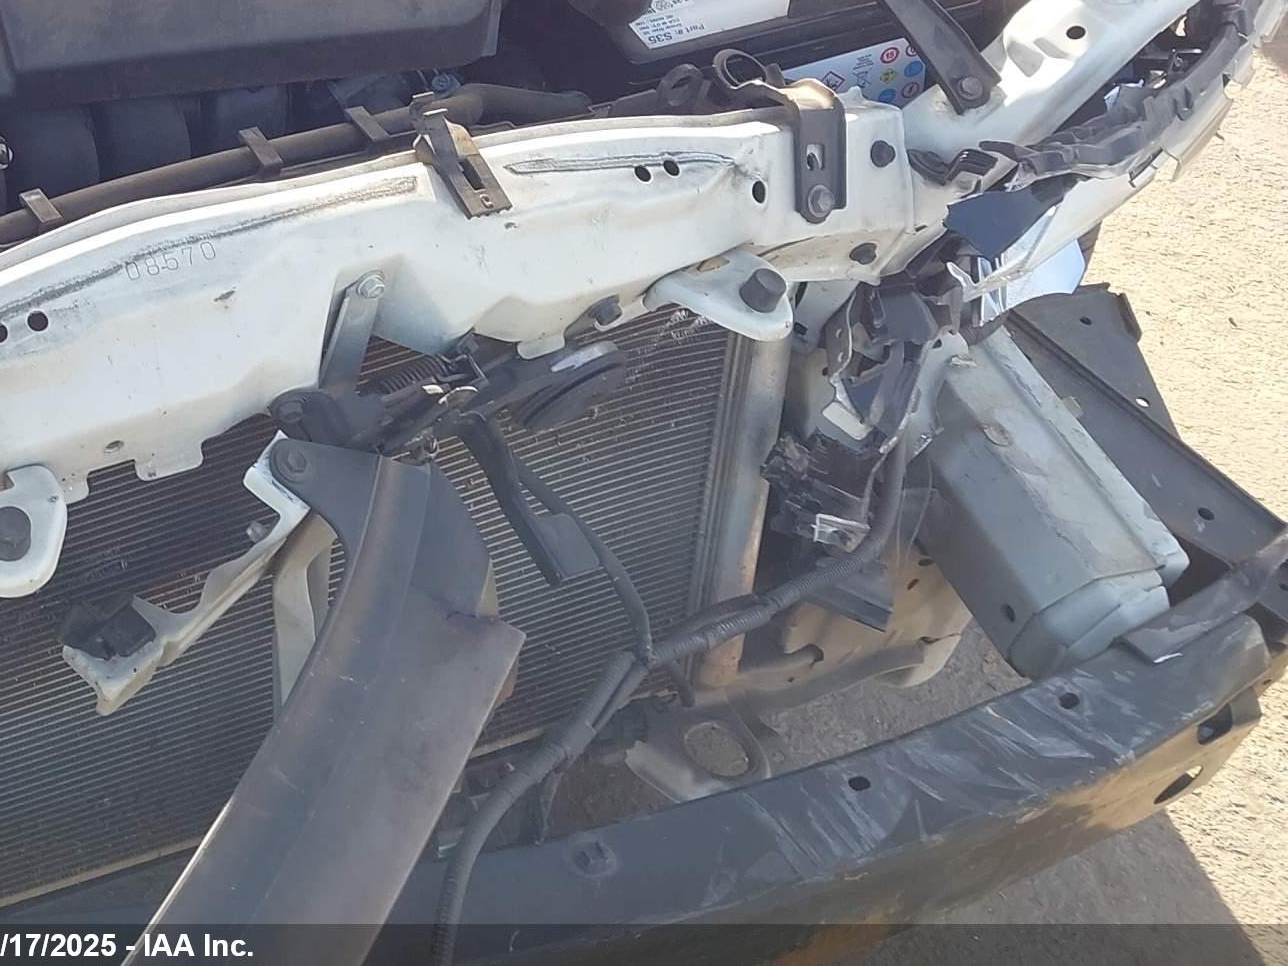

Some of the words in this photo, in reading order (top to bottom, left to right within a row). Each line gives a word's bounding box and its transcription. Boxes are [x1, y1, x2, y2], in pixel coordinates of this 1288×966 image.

[685, 23, 705, 34] Part
[648, 32, 672, 44] S35
[125, 241, 216, 281] 08570
